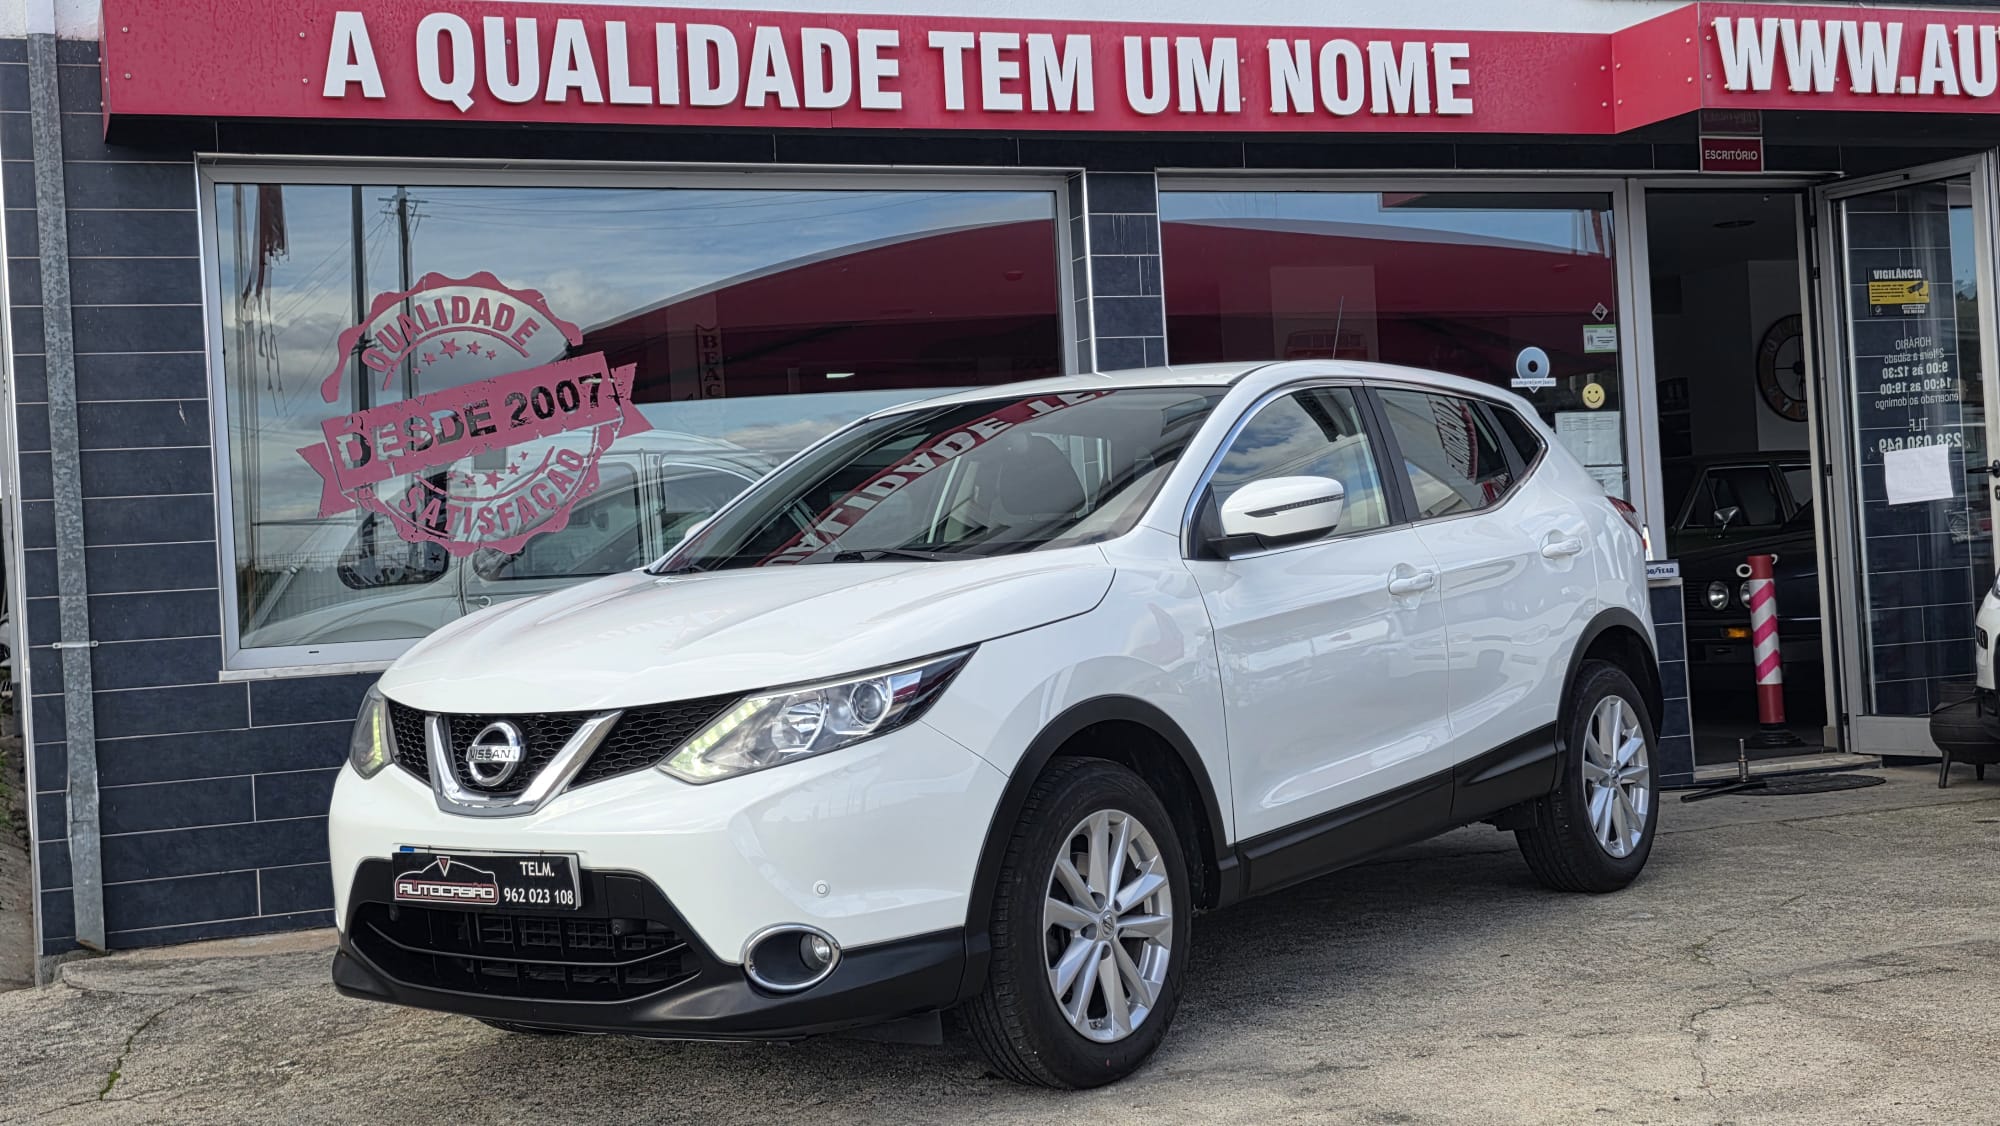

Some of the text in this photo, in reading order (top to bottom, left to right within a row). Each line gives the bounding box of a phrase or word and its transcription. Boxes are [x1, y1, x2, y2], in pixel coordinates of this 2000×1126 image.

[322, 10, 1475, 116] A QUALIDADE TEM UM NOME
[1713, 17, 2000, 98] WWW.AU
[1705, 149, 1758, 160] ESCRITÓRIO
[1873, 268, 1922, 280] VIGILÂNCIA
[362, 295, 541, 373] QUALIDADE
[334, 373, 602, 470] DESDE 2007
[468, 749, 512, 760] NISSAN
[519, 861, 555, 877] TELM.
[503, 888, 574, 905] 962 023 108
